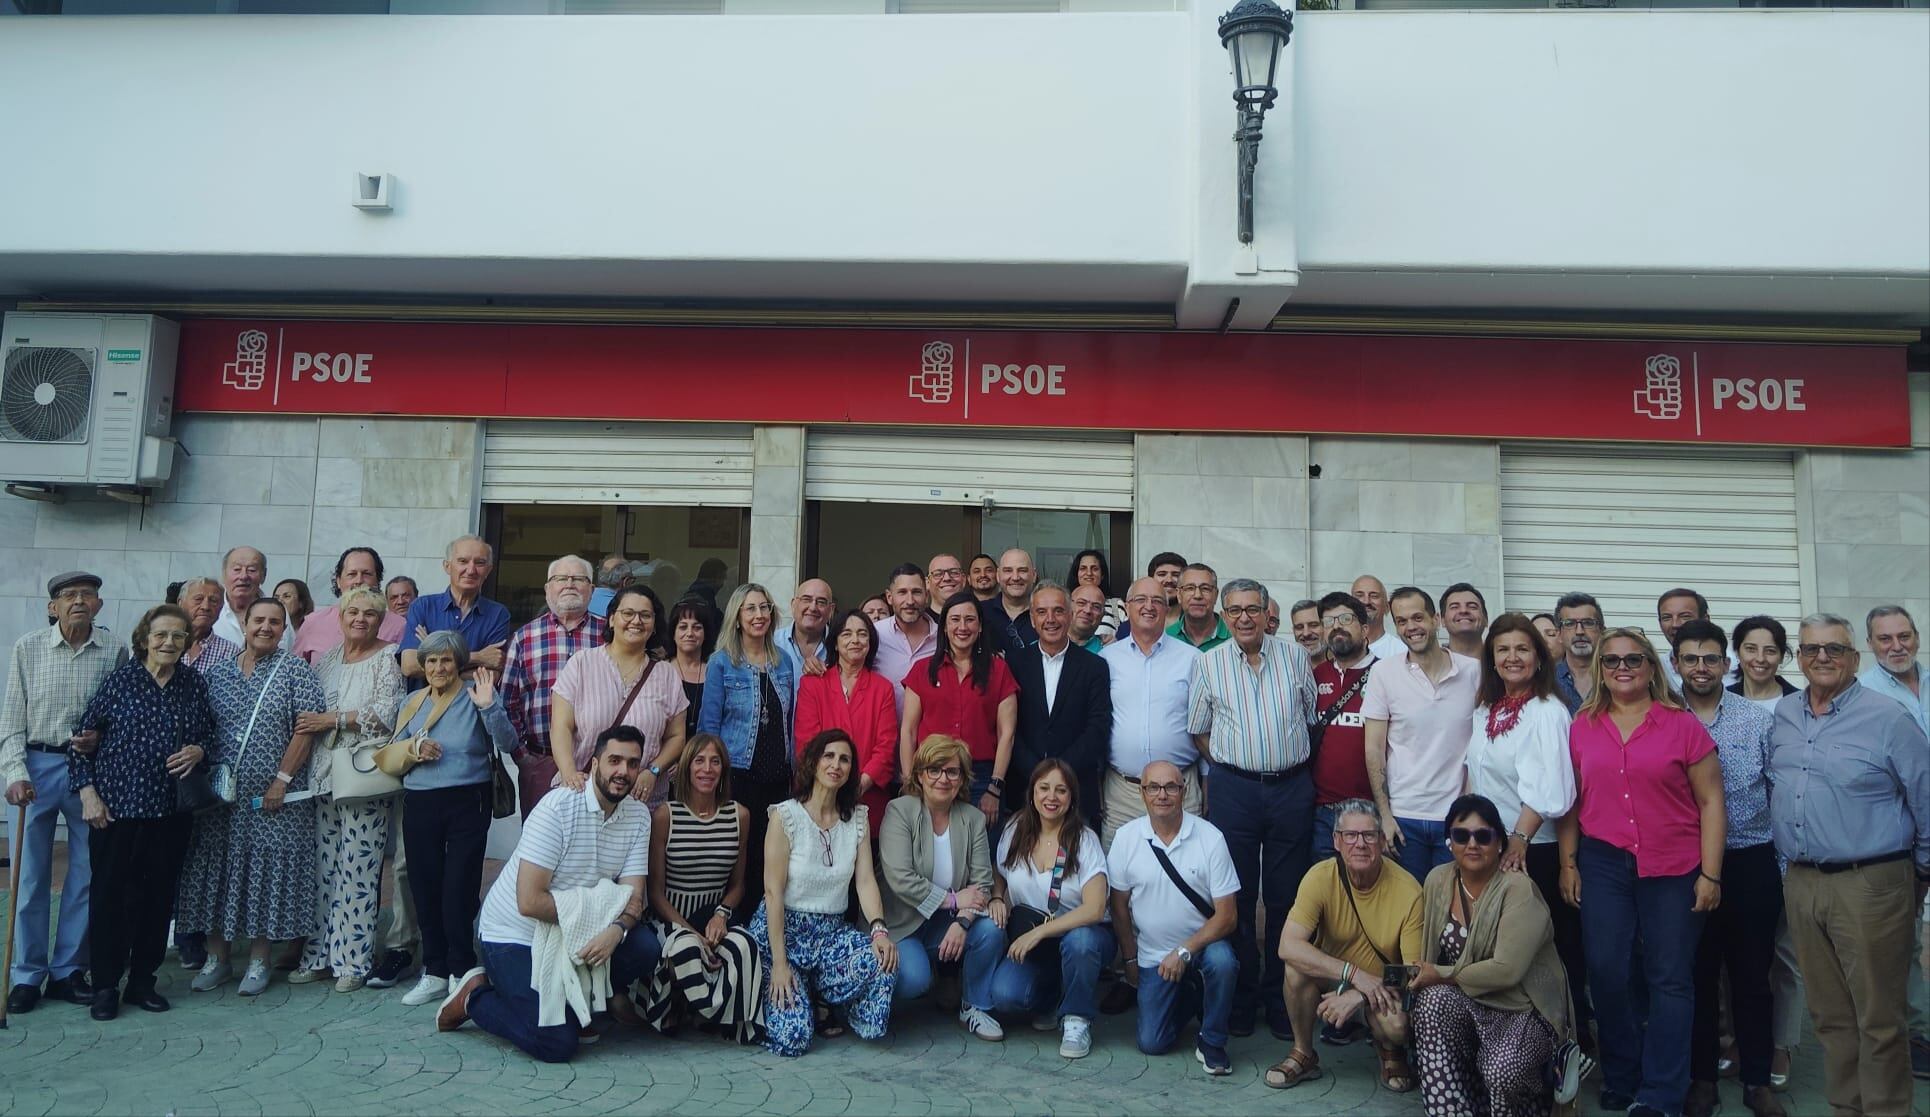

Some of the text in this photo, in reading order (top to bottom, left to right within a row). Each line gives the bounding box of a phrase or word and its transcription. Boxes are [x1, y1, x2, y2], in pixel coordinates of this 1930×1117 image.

[108, 351, 140, 360] Hisense
[291, 351, 374, 384] PSOE
[981, 363, 1067, 396] PSOE
[1711, 377, 1807, 412] PSOE
